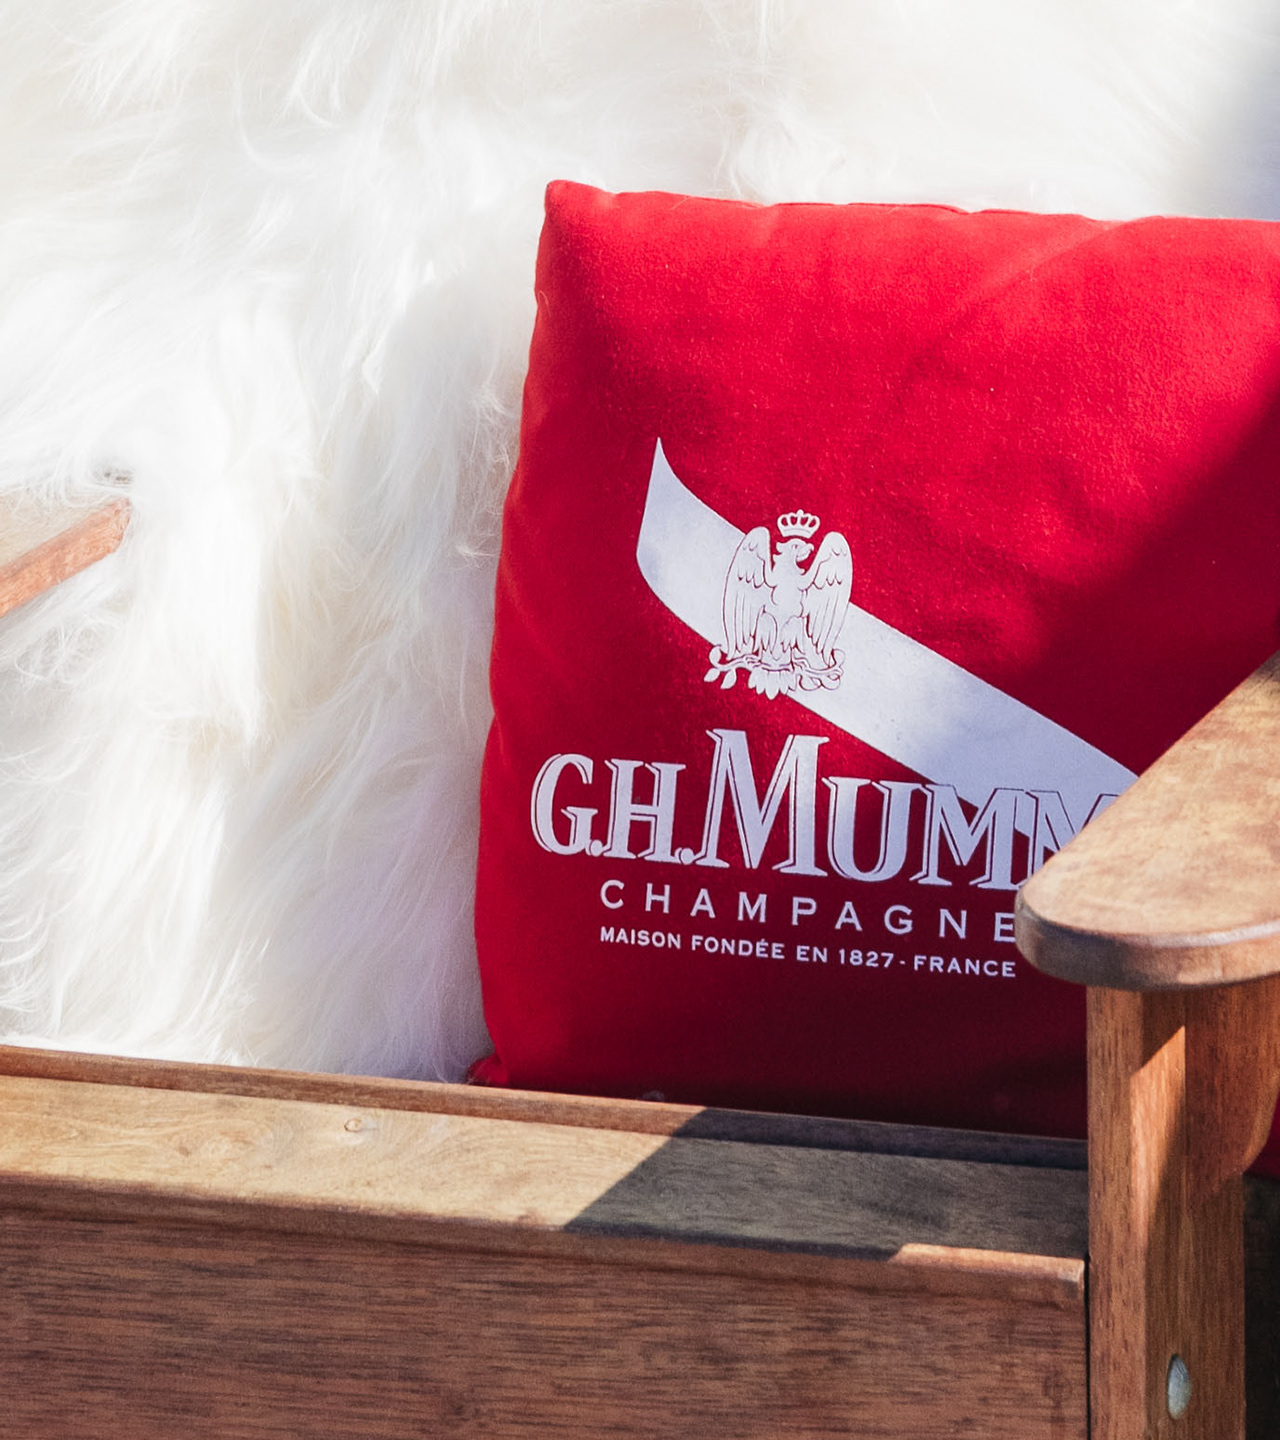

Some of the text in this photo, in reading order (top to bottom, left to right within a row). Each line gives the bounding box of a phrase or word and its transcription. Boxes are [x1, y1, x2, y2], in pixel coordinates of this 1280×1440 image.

[599, 878, 1016, 943] CHAMPAGNE
[599, 926, 682, 950] MAISON
[690, 935, 786, 960] FONDÉE
[796, 944, 828, 964] EN
